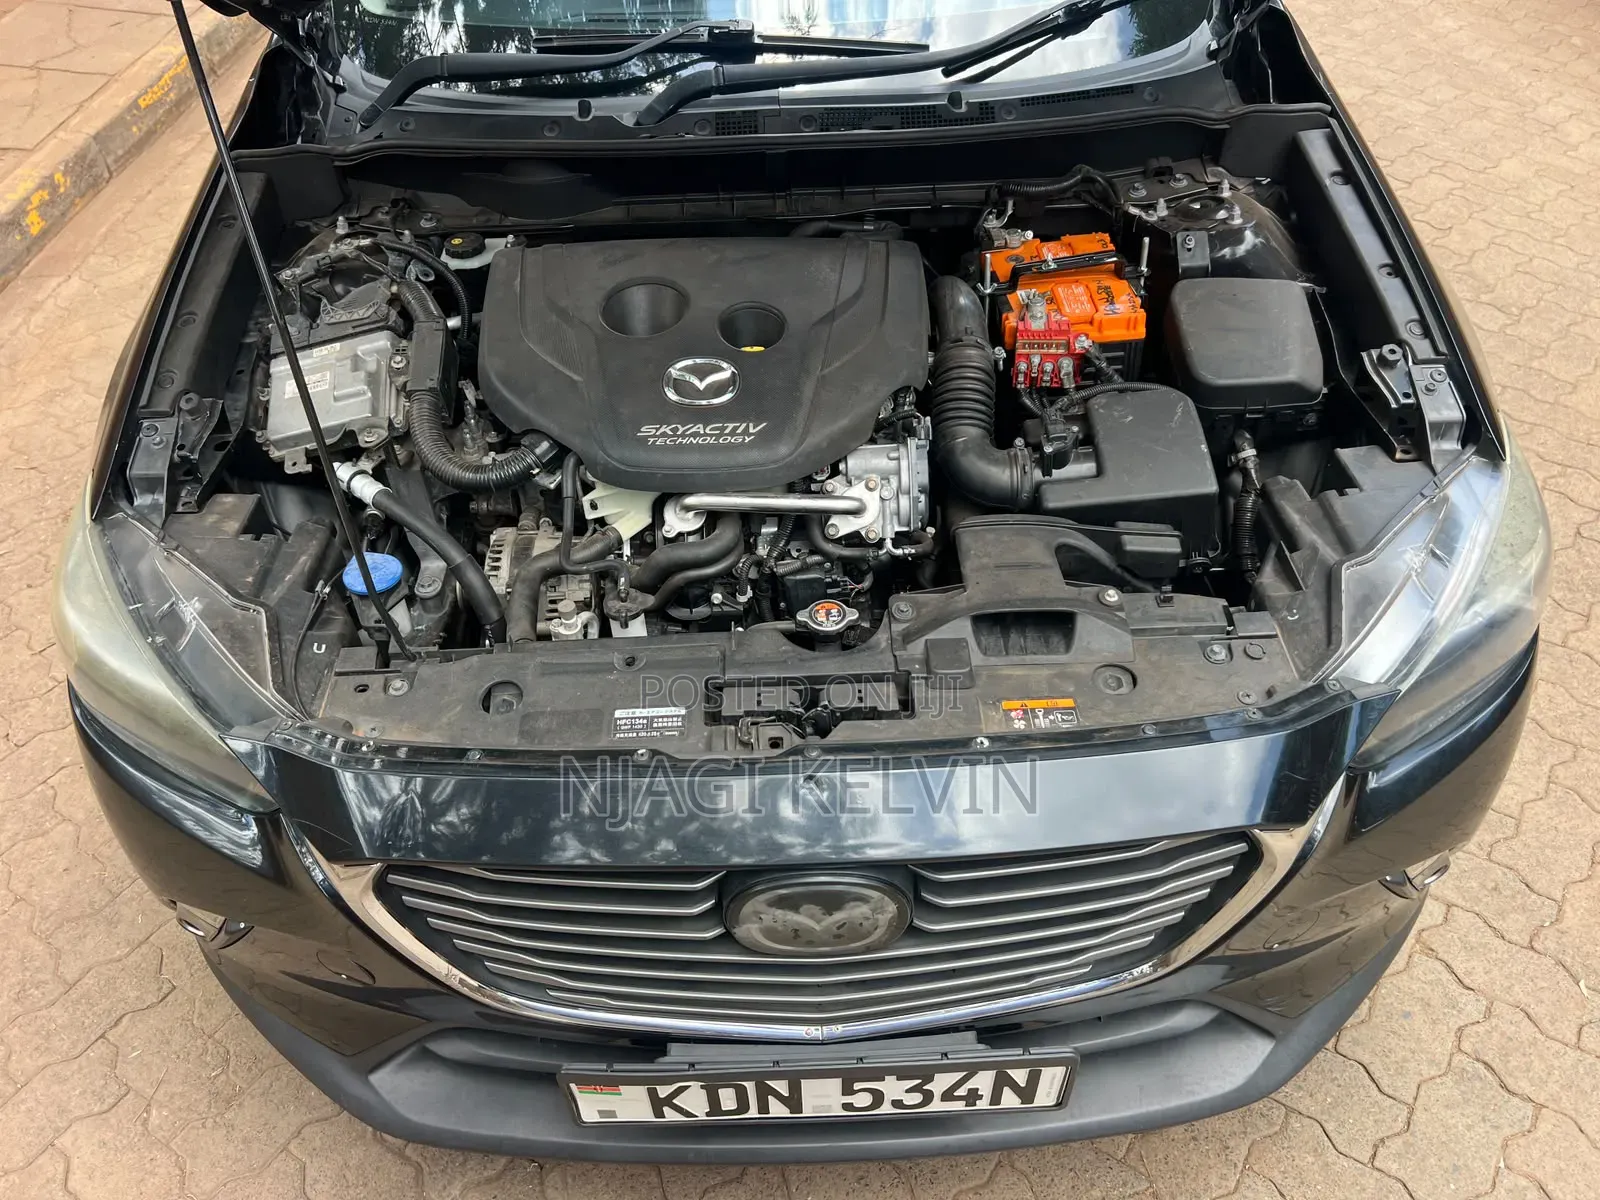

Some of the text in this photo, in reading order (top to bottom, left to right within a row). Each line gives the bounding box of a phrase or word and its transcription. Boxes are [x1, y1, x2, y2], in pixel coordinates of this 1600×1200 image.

[636, 422, 768, 436] SKYACTIV
[647, 435, 756, 446] TECHNOLOGY
[646, 1079, 802, 1119] KDN
[841, 1068, 1042, 1112] 534N
